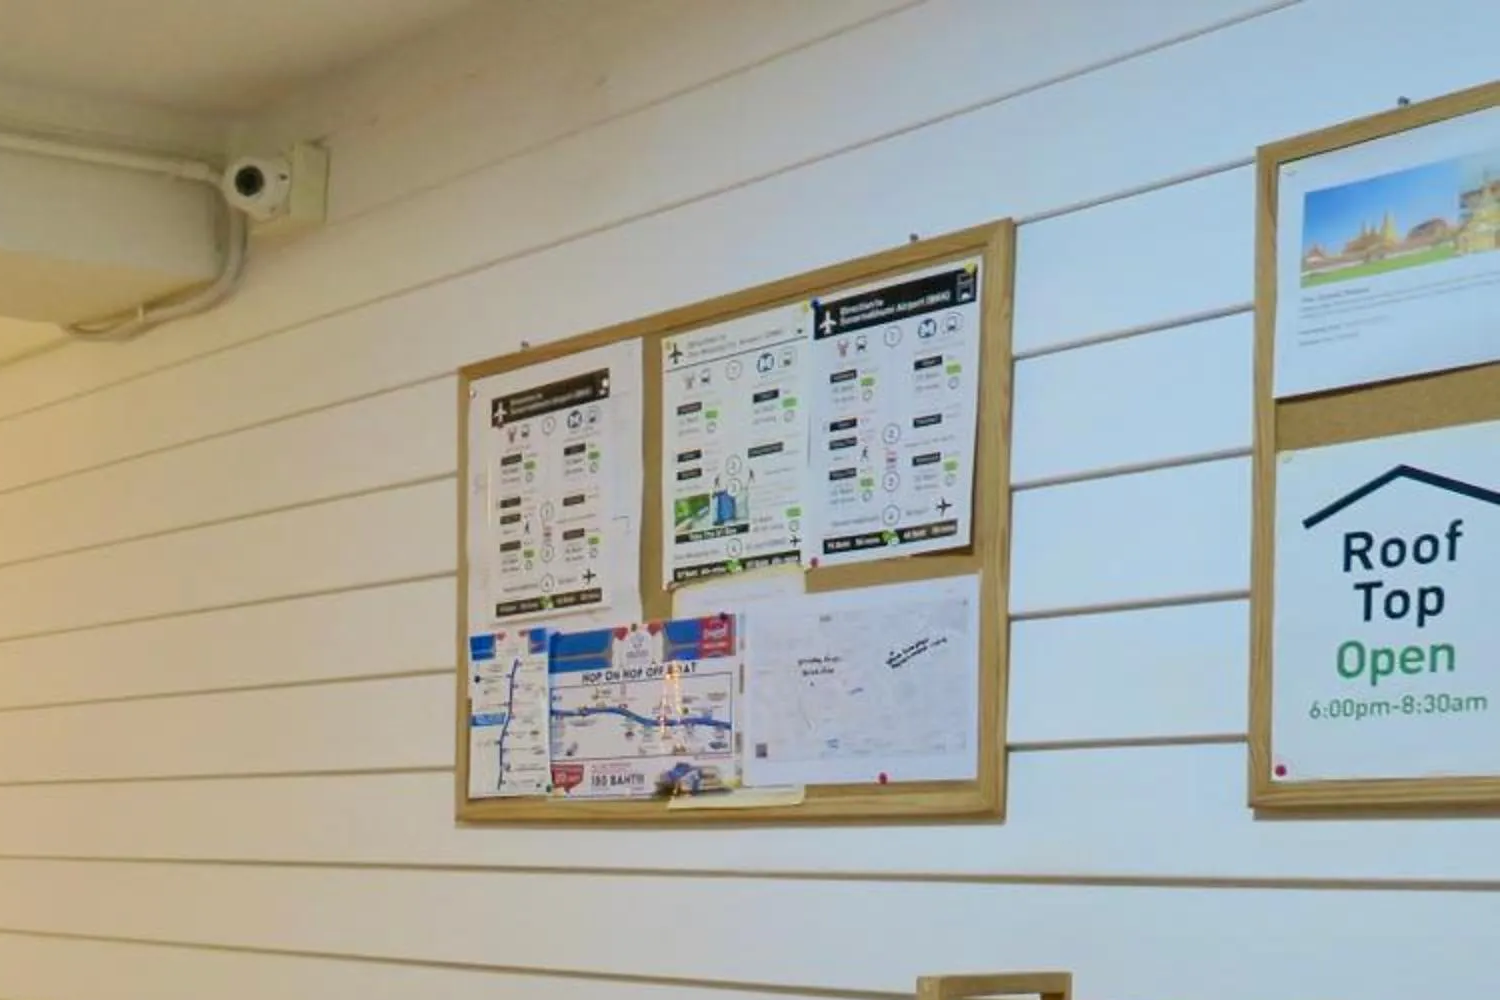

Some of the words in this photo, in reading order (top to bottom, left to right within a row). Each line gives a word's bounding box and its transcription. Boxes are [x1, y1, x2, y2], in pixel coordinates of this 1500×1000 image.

[1343, 518, 1464, 573] Roof
[1353, 580, 1445, 628] Top
[582, 670, 603, 683] HOP
[605, 670, 621, 682] ON
[623, 667, 644, 679] HOP
[646, 665, 665, 678] OFF
[1336, 639, 1456, 687] Open
[1308, 693, 1489, 720] 6:00pm-8:30am
